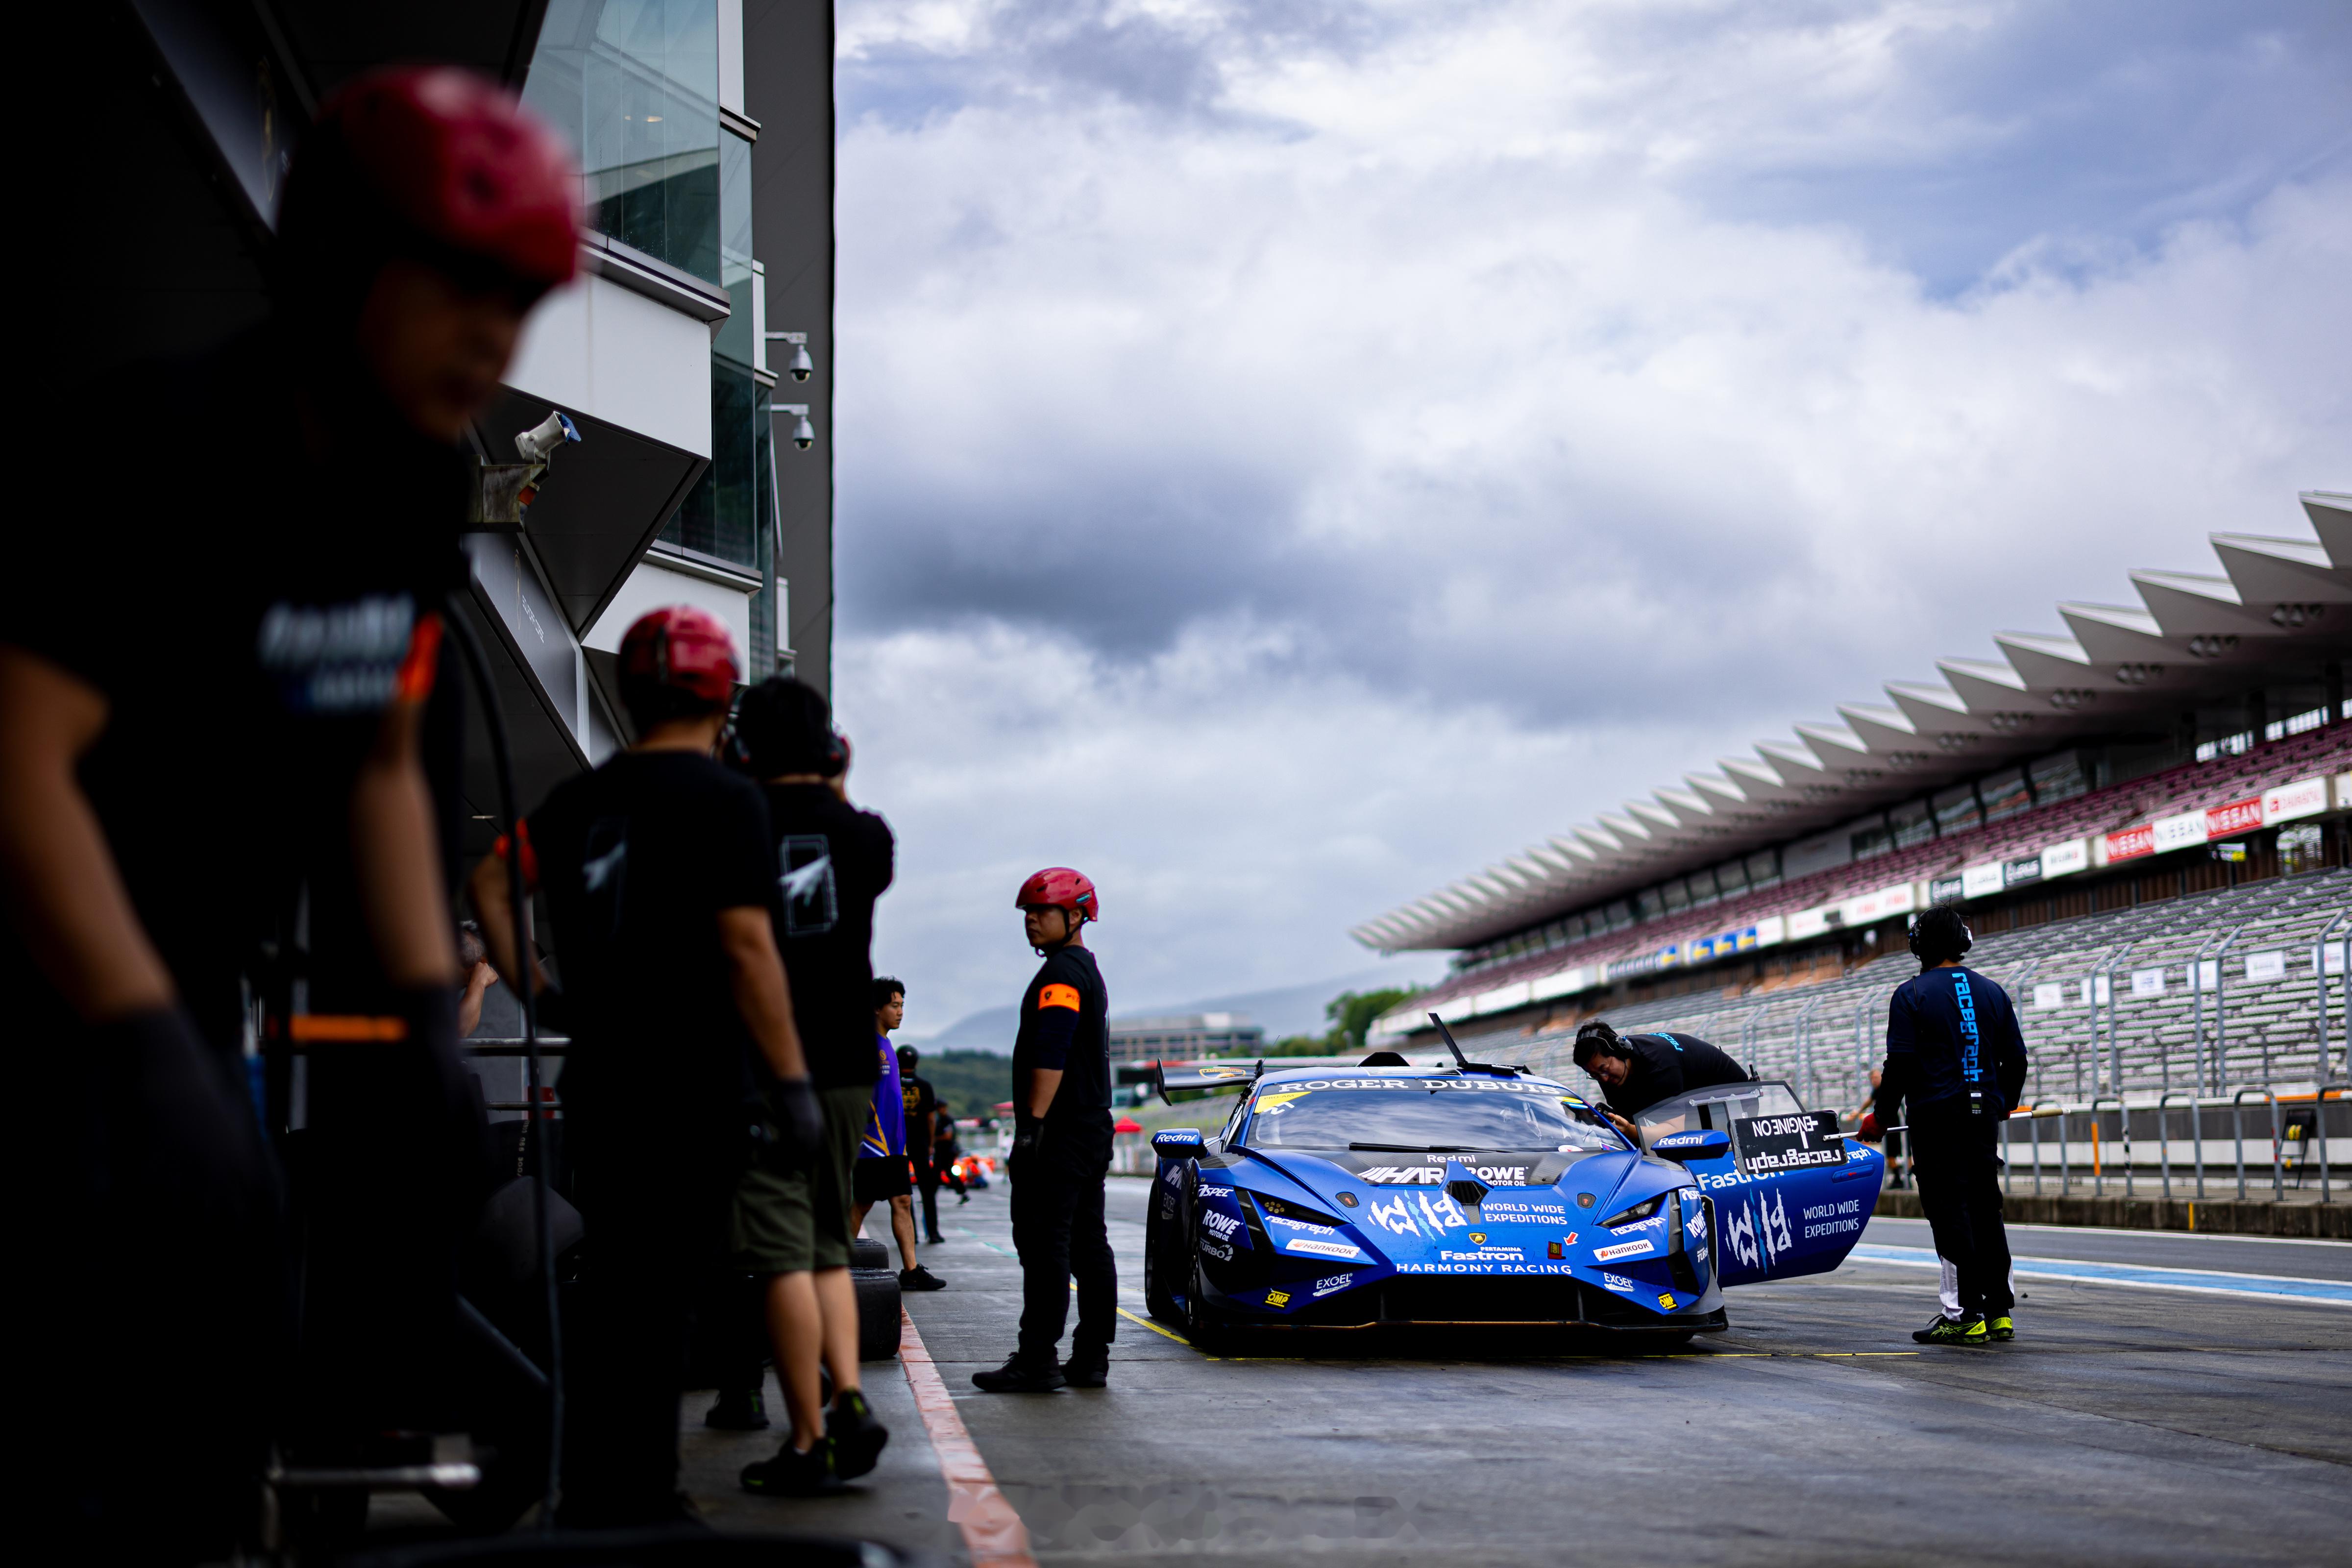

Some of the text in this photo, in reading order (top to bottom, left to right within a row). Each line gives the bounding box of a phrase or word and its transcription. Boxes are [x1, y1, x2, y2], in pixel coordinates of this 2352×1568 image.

[2207, 802, 2261, 833] NISSAN
[2107, 830, 2153, 857] NISSAN
[1952, 972, 1984, 1082] racegraph
[1278, 1078, 1560, 1095] ROGER DUBUIS
[1752, 1115, 1814, 1137] ENGINE ON
[1156, 1133, 1197, 1143] Redmi
[1659, 1135, 1703, 1146] Redmi
[1426, 1154, 1476, 1163] Redmi
[1745, 1148, 1842, 1174] racegraph
[1481, 1202, 1566, 1214] WORLD WIDE
[1804, 1199, 1860, 1220] WORLD WIDE
[1202, 1209, 1240, 1235] ROWE
[1265, 1215, 1335, 1236] racegraph
[1485, 1213, 1568, 1225] EXPEDITIONS
[1610, 1217, 1666, 1237] racegraph
[1208, 1228, 1222, 1240] MOTOR
[1805, 1218, 1860, 1239] EXPEDITIONS
[1200, 1240, 1225, 1259] TURBO
[1441, 1250, 1524, 1261] Fastron
[1396, 1264, 1571, 1274] HARMONY RACING
[1268, 1293, 1289, 1304] OMP
[1659, 1296, 1674, 1307] OMP
